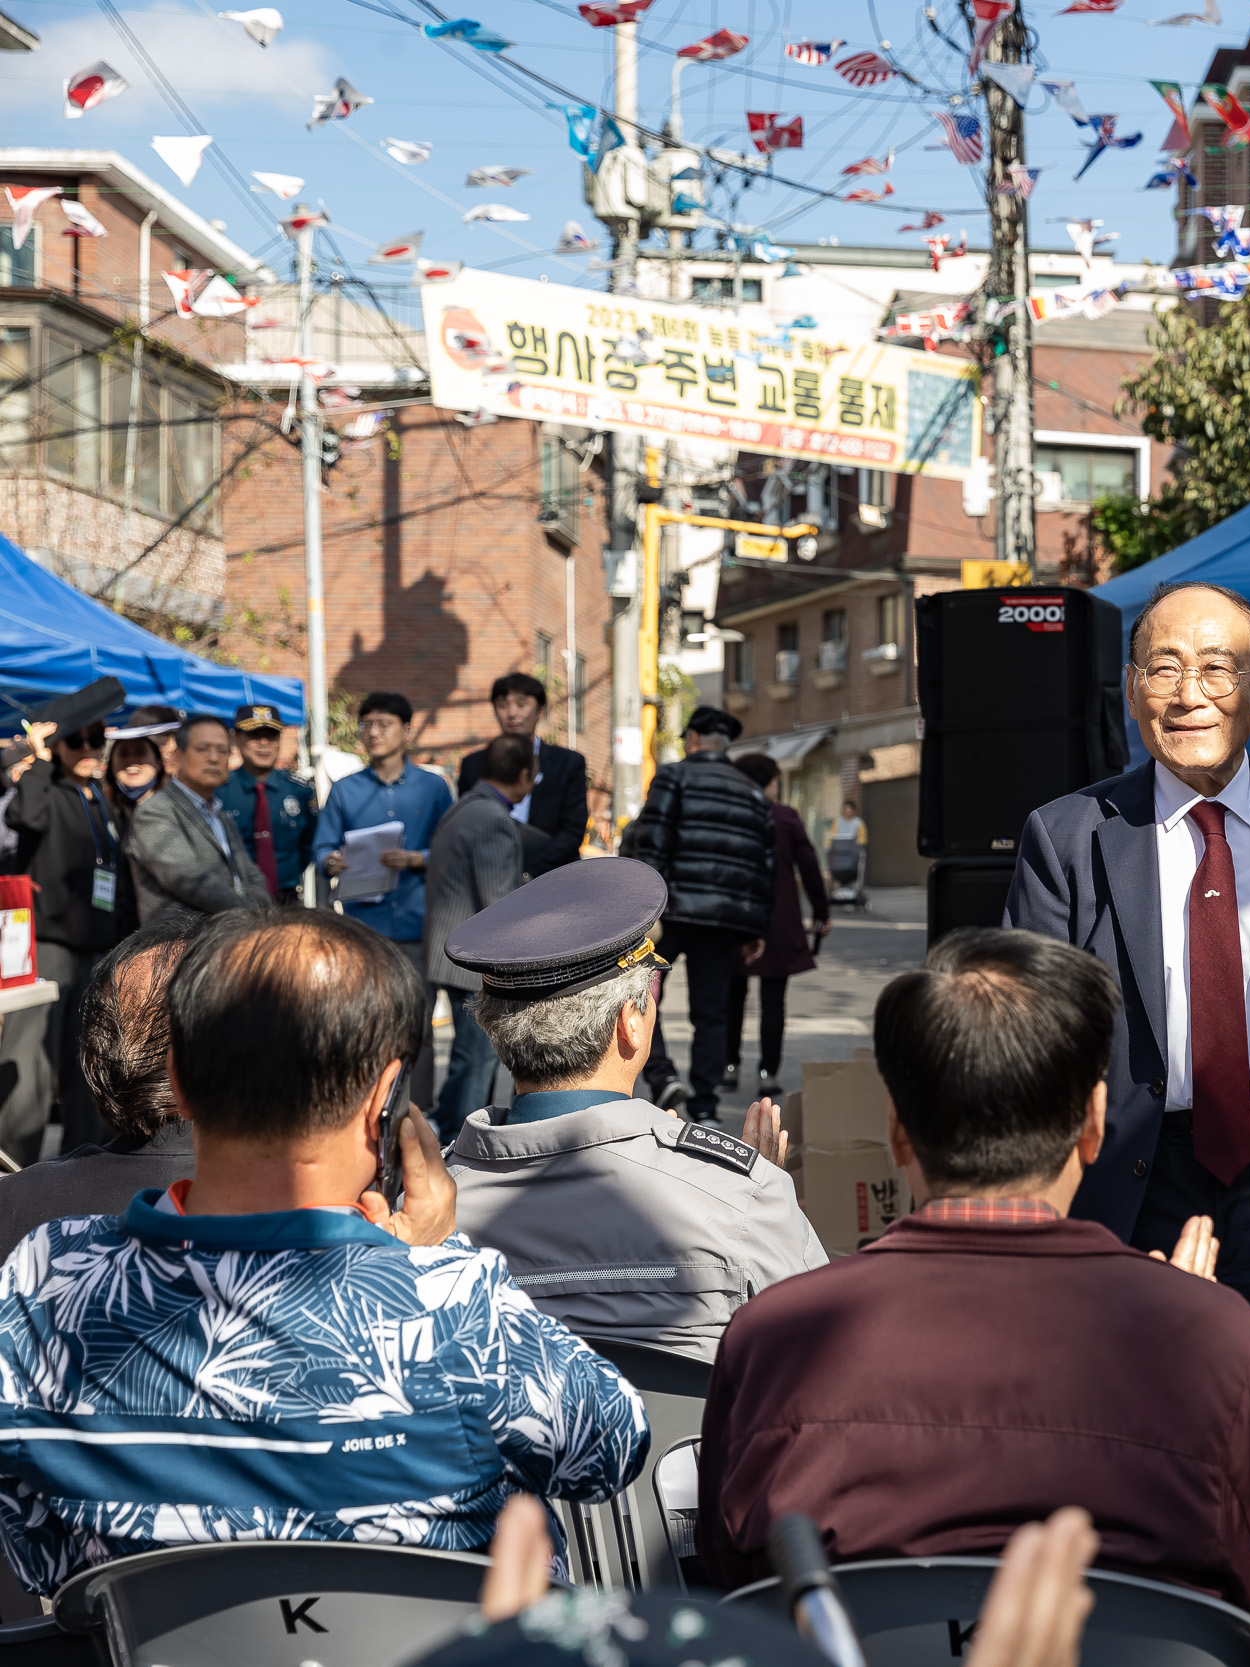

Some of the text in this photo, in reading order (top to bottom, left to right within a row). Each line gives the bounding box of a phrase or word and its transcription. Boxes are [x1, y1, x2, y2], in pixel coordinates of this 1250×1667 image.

[664, 349, 737, 407] 주변
[758, 364, 821, 420] 교통
[840, 377, 896, 430] 통제
[998, 606, 1061, 623] 2000
[341, 1437, 374, 1453] JOIE
[374, 1434, 395, 1450] DE
[279, 1596, 329, 1635] K
